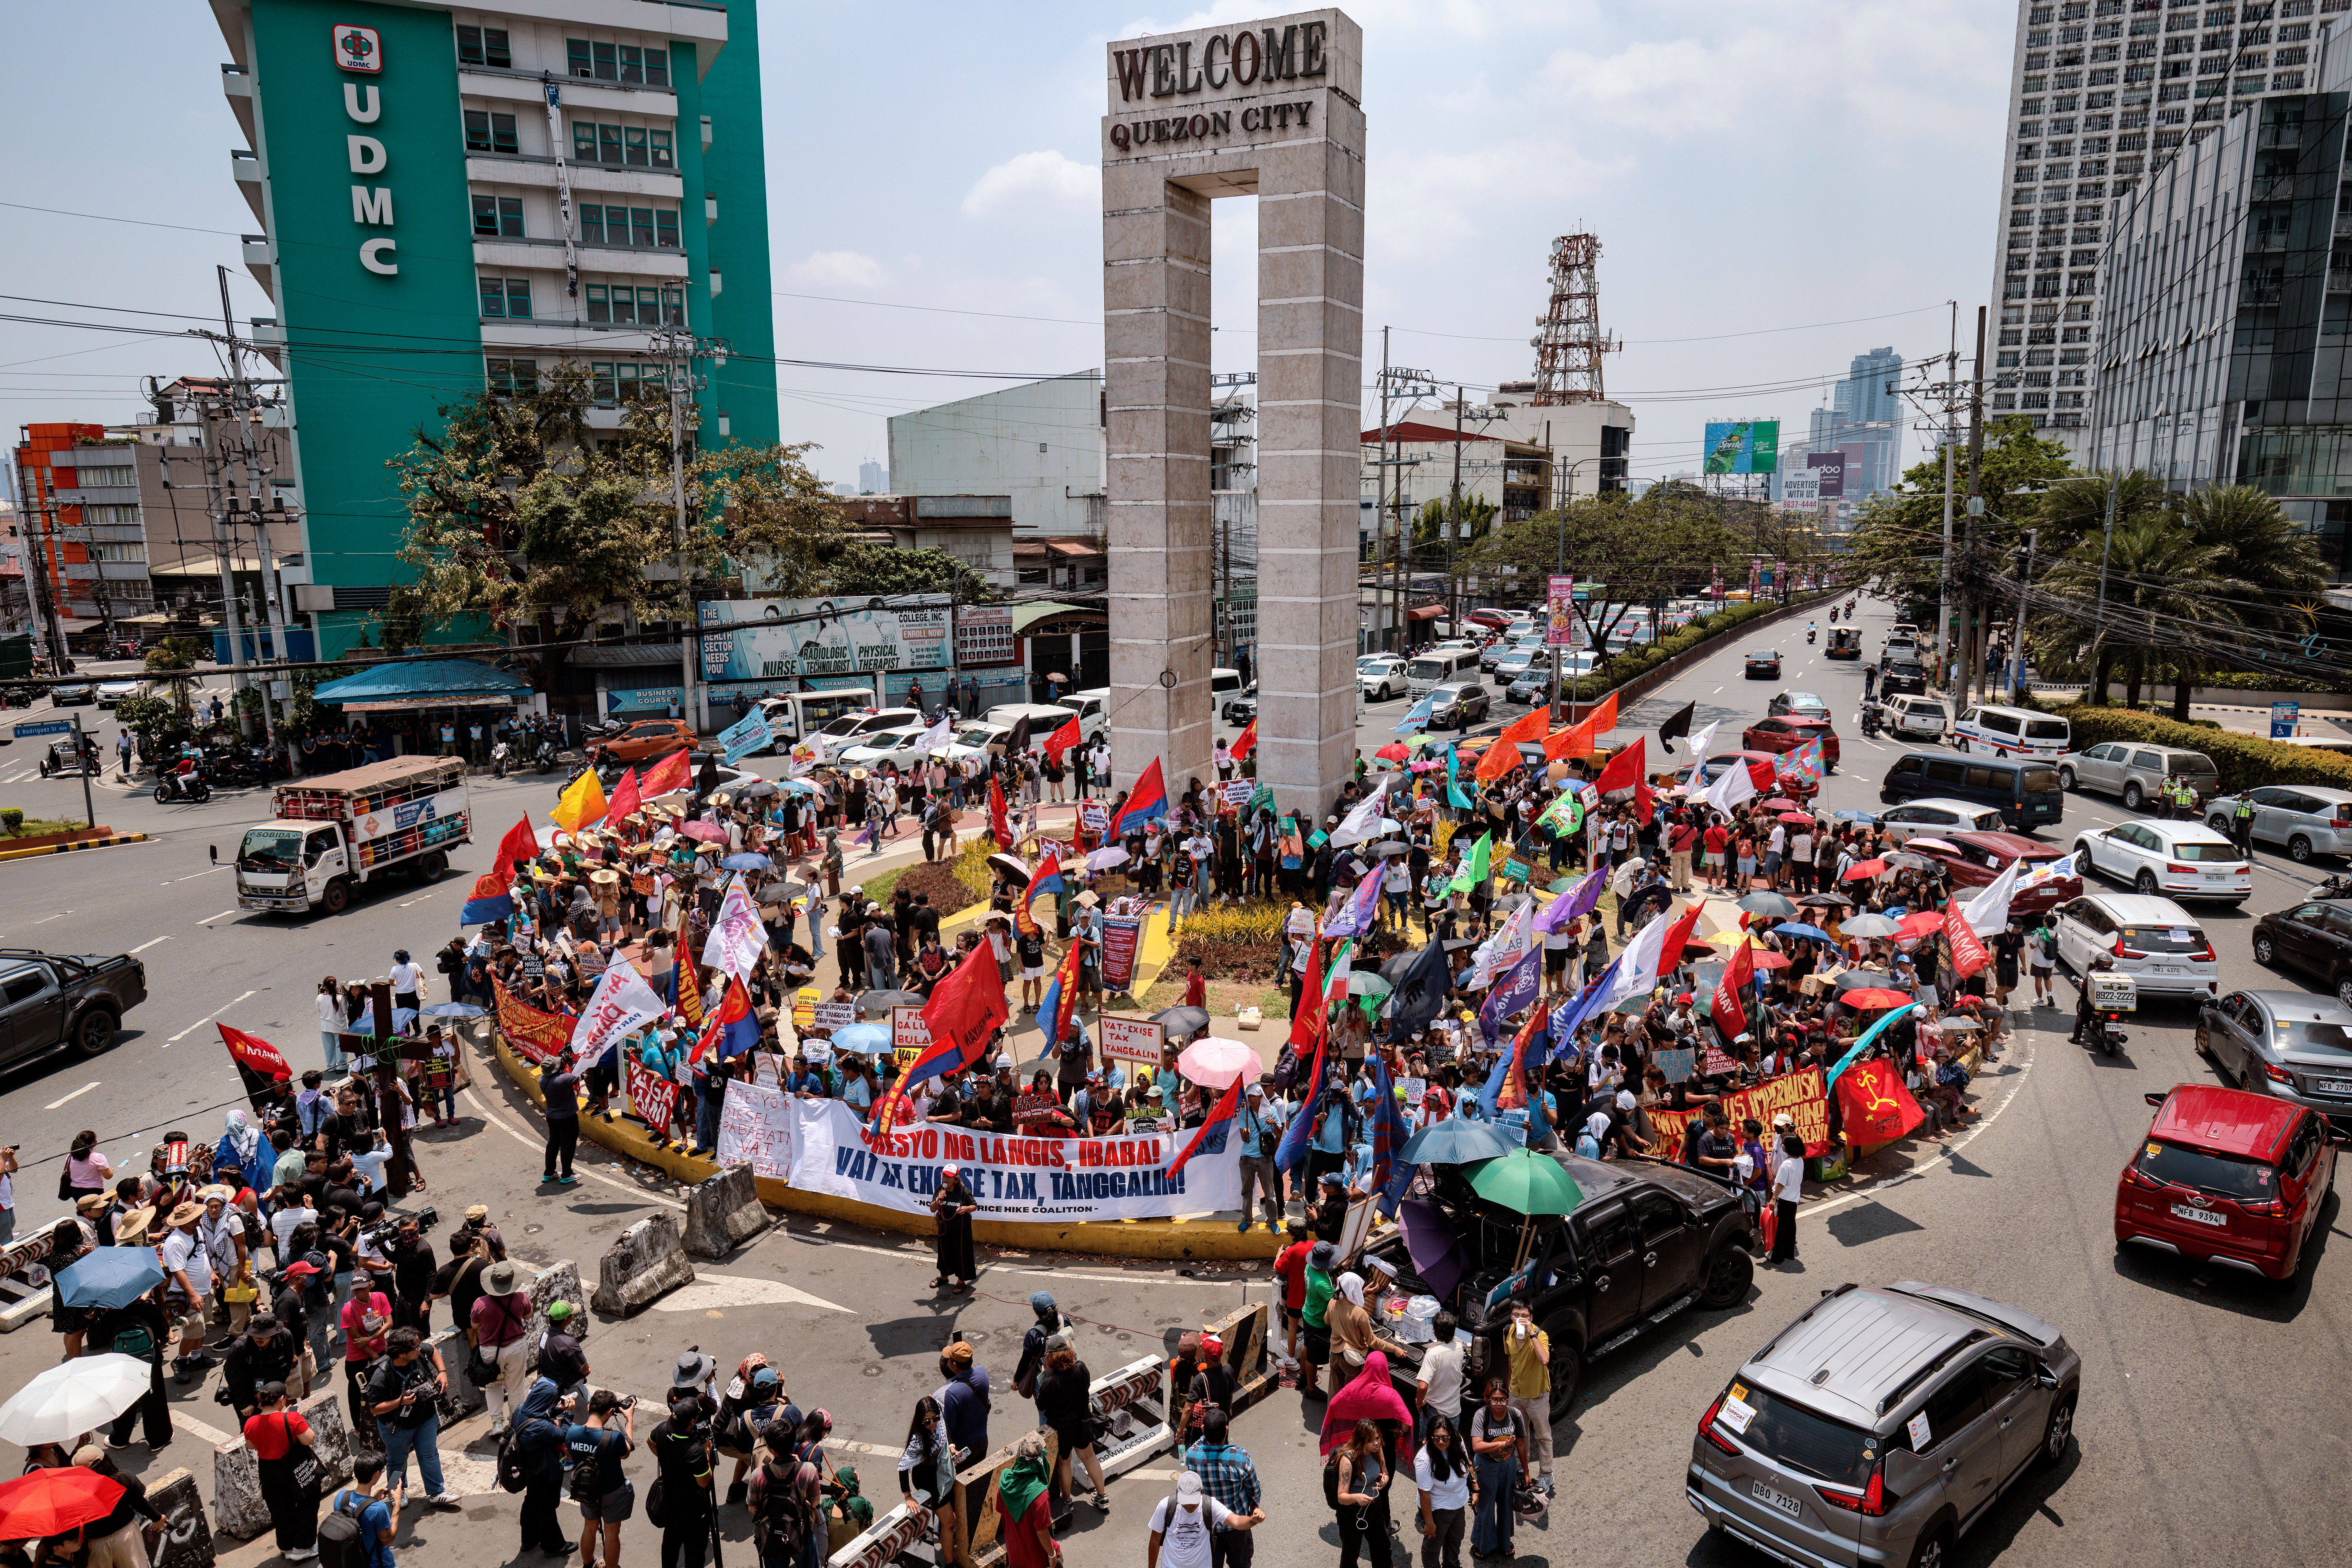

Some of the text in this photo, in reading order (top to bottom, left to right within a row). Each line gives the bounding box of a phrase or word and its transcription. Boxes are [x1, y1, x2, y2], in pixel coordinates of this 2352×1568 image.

[347, 60, 370, 69] UDMC
[1113, 20, 1327, 102] WELCOME
[1110, 101, 1313, 151] QUEZON CITY
[343, 83, 398, 275] UDMC
[1719, 441, 1742, 450] Sprite
[1784, 481, 1818, 489] ADVERTISE
[1550, 588, 1571, 596] delicious
[702, 609, 717, 619] THE
[899, 613, 944, 623] COLLEGE, INC.
[904, 629, 944, 638] ENROLL NOW!
[704, 642, 733, 652] SECTOR
[829, 637, 837, 645] BE
[705, 653, 729, 663] NEEDS
[779, 651, 788, 659] BE
[803, 646, 847, 660] RADIOLOGIC
[858, 644, 898, 658] PHYSICAL
[706, 664, 724, 674] YOU!
[762, 660, 797, 677] NURSE
[806, 659, 850, 674] TECHNOLOGIST
[858, 657, 900, 671] THERAPIST
[677, 957, 702, 1024] PISTON
[2096, 991, 2135, 1001] 8922-2222
[1104, 1021, 1153, 1037] VAT-EXISE
[1109, 1033, 1129, 1042] TAX
[1105, 1044, 1158, 1060] TANGGALIN
[1707, 1055, 1727, 1063] BULOK
[1707, 1059, 1735, 1070] SISTEMA!
[1396, 1078, 1419, 1086] FOREIGN
[725, 1086, 778, 1109] PRESYO
[1723, 1067, 1820, 1126] US IMPERIALISM!
[724, 1107, 771, 1126] DIESEL
[740, 1138, 773, 1158] VAT
[944, 1131, 975, 1161] NG
[979, 1137, 1072, 1172] LANGIS,
[1079, 1139, 1160, 1167] IBABA!
[835, 1145, 1186, 1207] VAT AT EXCSE TAX, TANGGALIN!
[1032, 1205, 1093, 1214] COALITION
[2178, 1204, 2219, 1224] NFB 9394
[1726, 1406, 1746, 1422] SUPPORT
[571, 1442, 598, 1454] MEDIA
[1776, 1494, 1799, 1513] 7128
